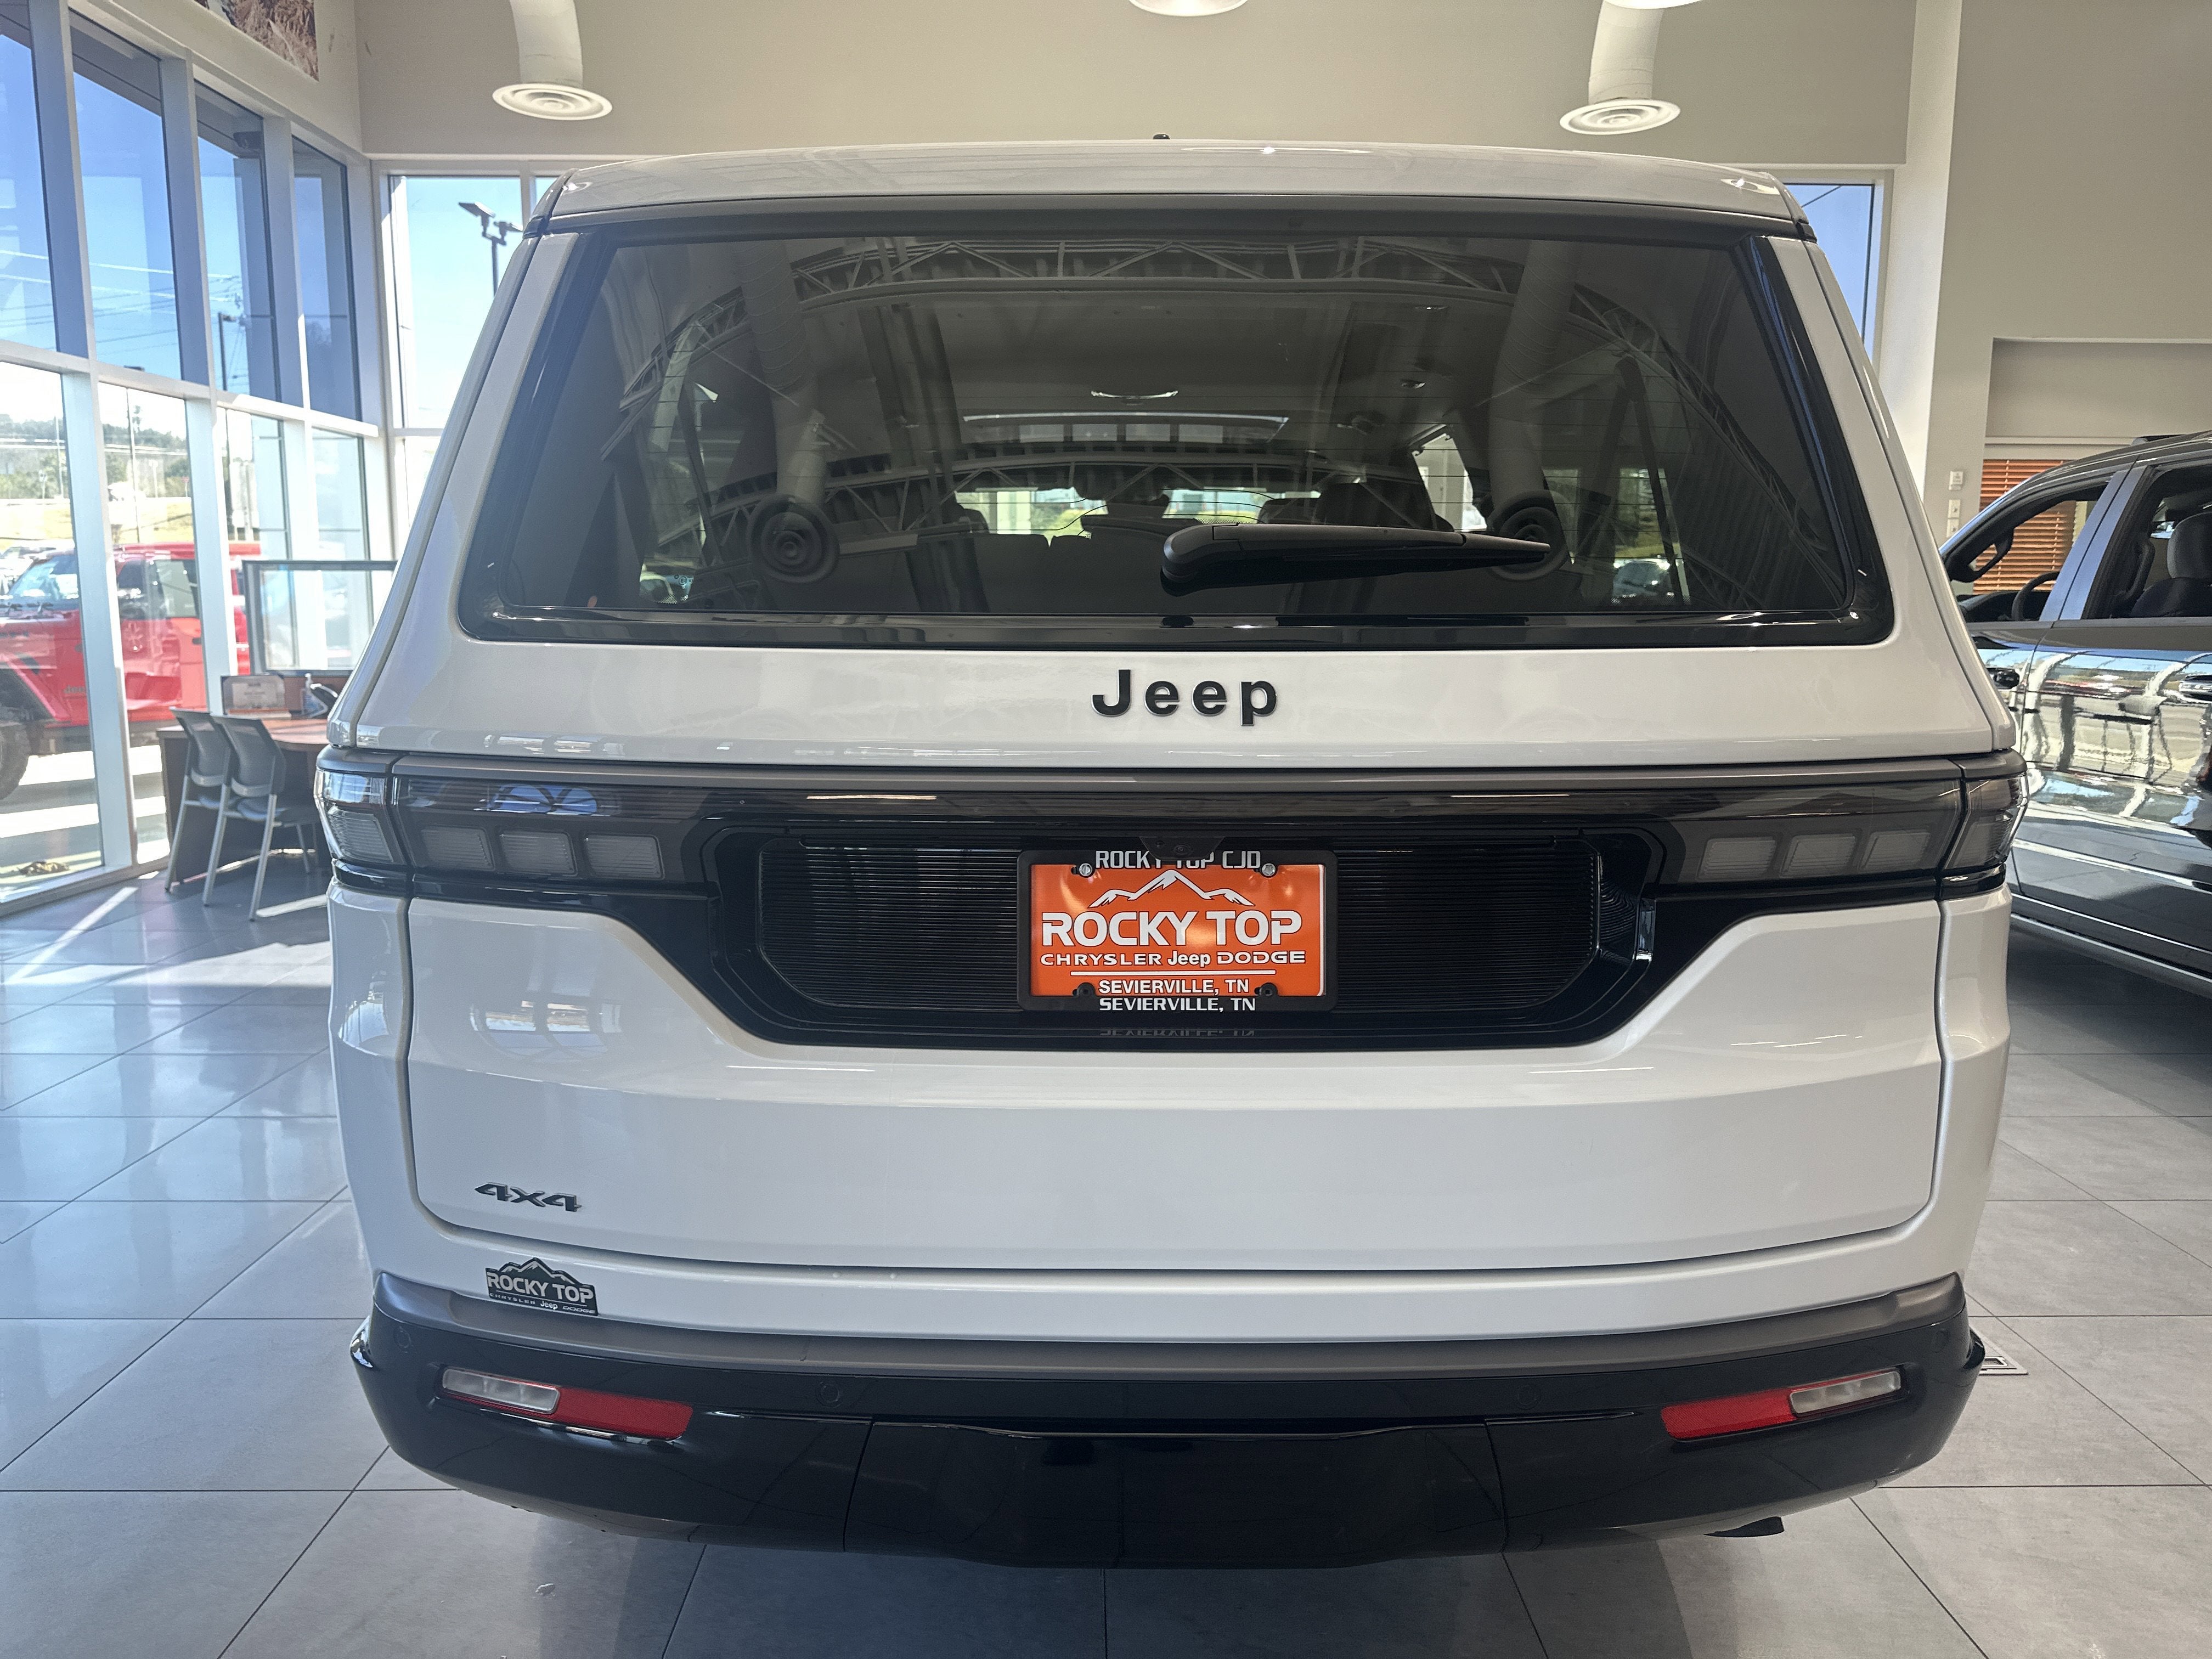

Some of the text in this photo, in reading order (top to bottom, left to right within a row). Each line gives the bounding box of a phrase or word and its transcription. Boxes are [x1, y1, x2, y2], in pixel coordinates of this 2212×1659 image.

[1091, 669, 1277, 726] Jeep
[1222, 850, 1261, 868] CJD
[1042, 910, 1302, 946] ROCKY TOP
[1040, 950, 1306, 968] CHRYSLER Jeep DODGE
[1098, 978, 1249, 995] SEVIERVILLE, TN
[1099, 997, 1256, 1012] SEVIERVILLE, TN
[487, 1272, 594, 1304] ROCKY TOP
[489, 1293, 596, 1314] CHRYSLER Jeep DODGE
